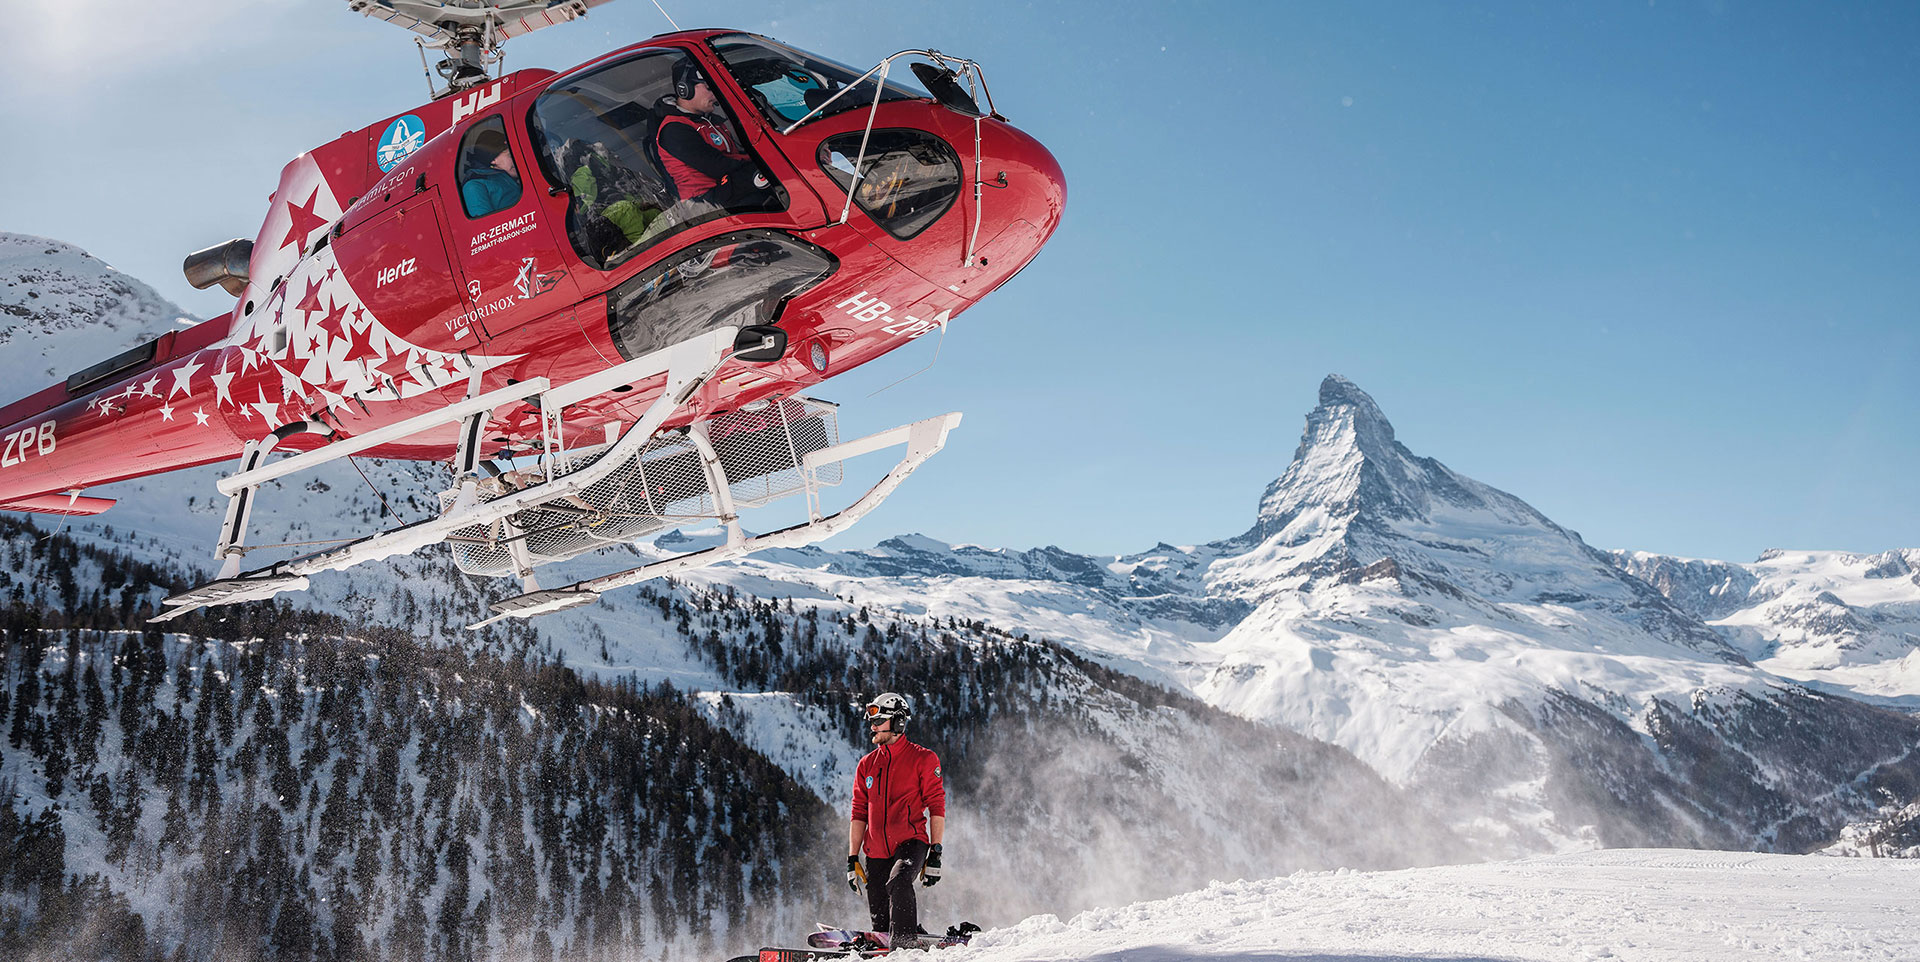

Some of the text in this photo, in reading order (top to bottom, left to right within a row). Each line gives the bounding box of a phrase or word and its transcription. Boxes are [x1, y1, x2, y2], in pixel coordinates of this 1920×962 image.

[470, 210, 536, 248] AIR-ZERMATT
[470, 222, 537, 256] ZERMATT-RARON-SION
[445, 294, 516, 333] VICTORINOX
[835, 290, 942, 339] HB-ZPB
[1, 419, 57, 469] ZPB
